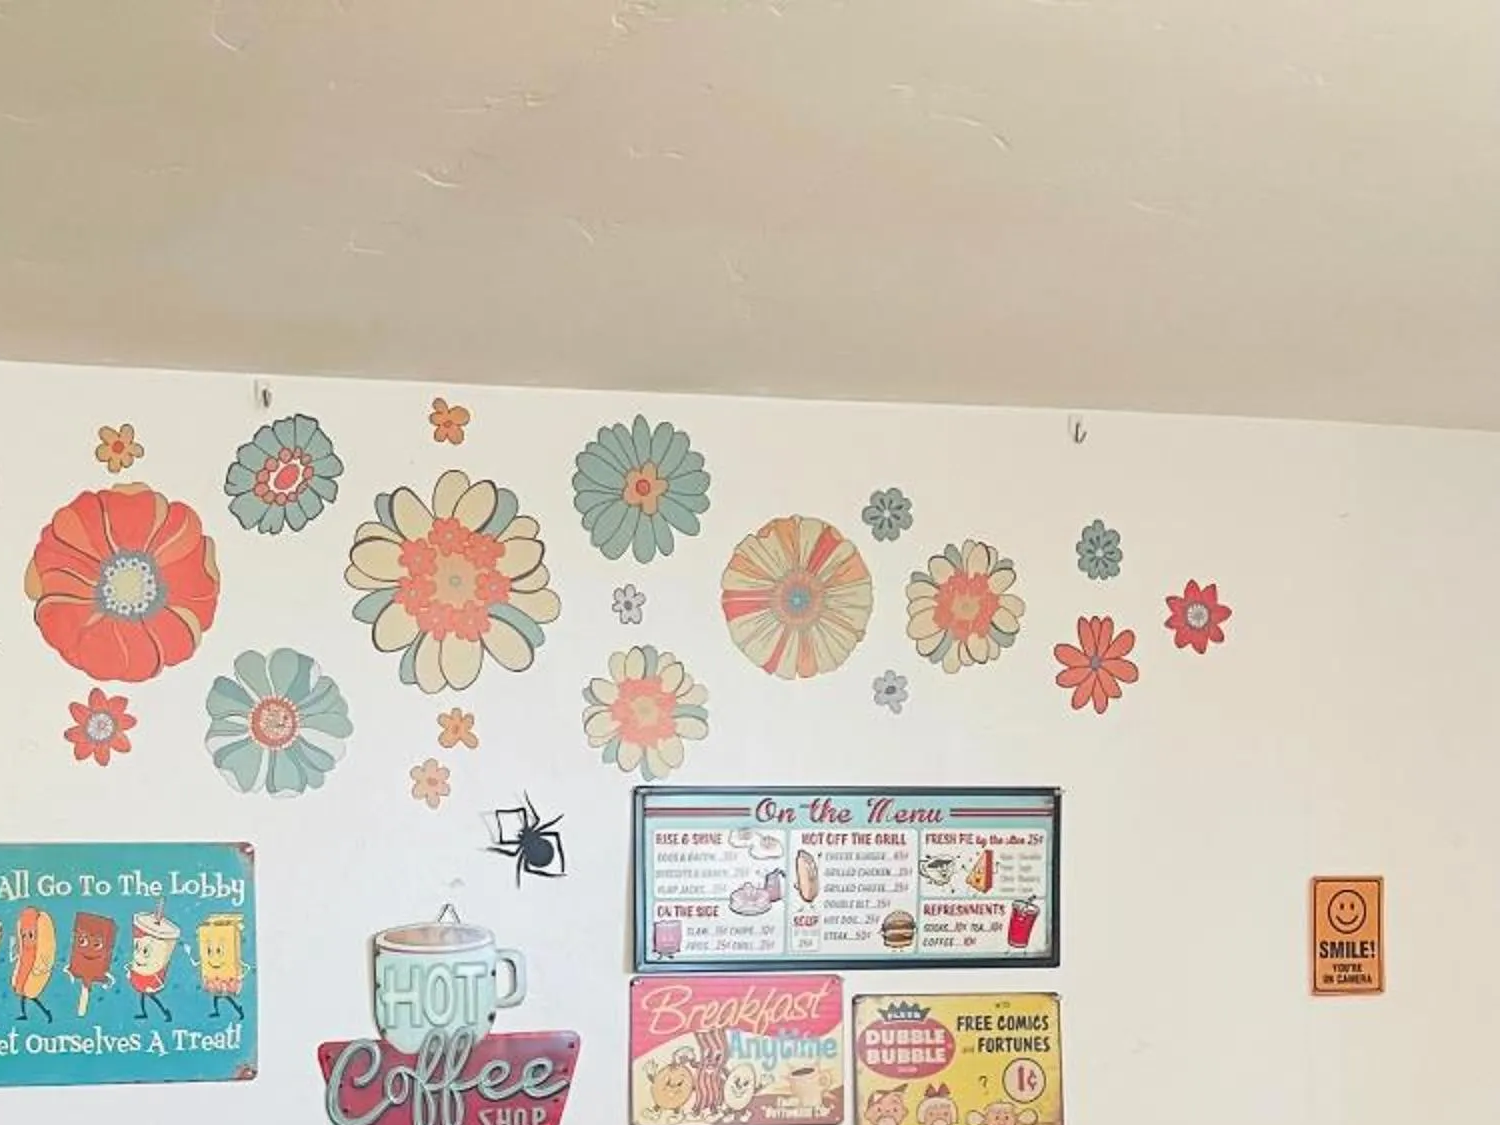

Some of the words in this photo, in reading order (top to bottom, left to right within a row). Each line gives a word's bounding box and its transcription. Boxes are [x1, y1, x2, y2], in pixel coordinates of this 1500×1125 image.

[756, 797, 796, 823] On
[800, 797, 852, 824] the
[867, 797, 944, 824] Menu
[826, 833, 848, 845] OFF
[852, 832, 872, 845] THE
[875, 833, 907, 845] GRILL
[926, 833, 957, 845] FRESH
[37, 875, 72, 898] Go
[79, 875, 111, 898] To
[118, 870, 162, 898] The
[169, 871, 245, 906] Lobby
[1319, 941, 1375, 959] SMILE!
[382, 962, 488, 1028] HOT
[641, 978, 831, 1035] Breakfast
[957, 1015, 993, 1031] FREE
[997, 1015, 1049, 1031] COMICS
[146, 1031, 168, 1057] A
[172, 1023, 241, 1051] Treat!
[865, 1028, 946, 1046] DUBBLE
[977, 1036, 1051, 1053] FORTUNES
[729, 1029, 838, 1070] Anytime
[867, 1048, 947, 1065] BUBBLE
